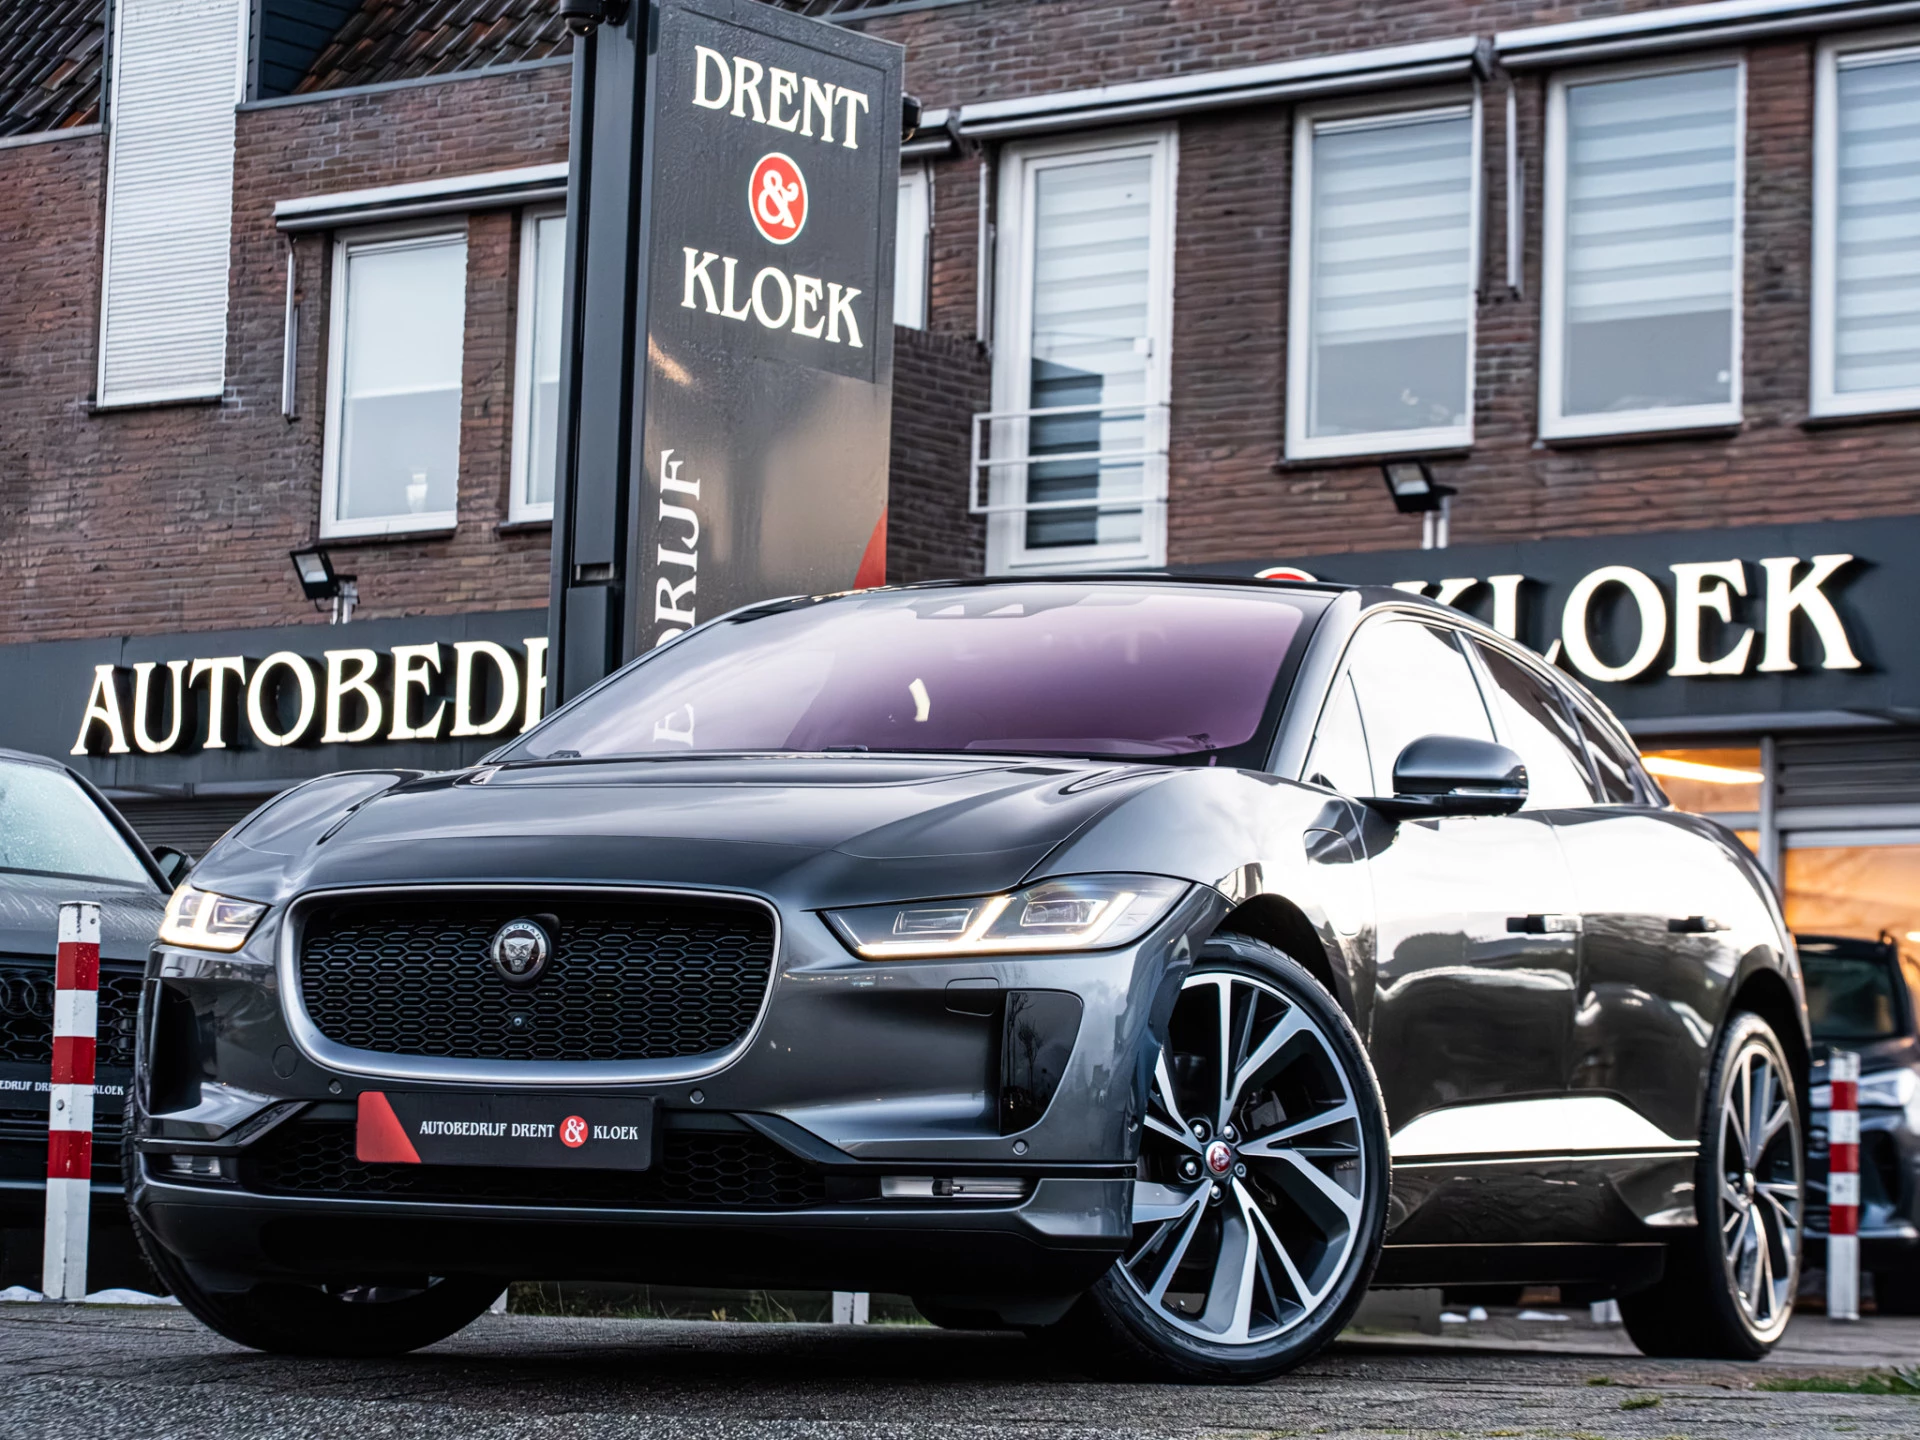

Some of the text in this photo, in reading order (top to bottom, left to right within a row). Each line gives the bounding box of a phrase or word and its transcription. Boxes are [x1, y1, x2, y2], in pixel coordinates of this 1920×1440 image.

[692, 45, 869, 149] DRENT
[757, 169, 799, 229] &
[681, 246, 863, 348] KLOEK
[419, 1118, 639, 1143] AUTOBEDRIJF DRENT & KLOEK
